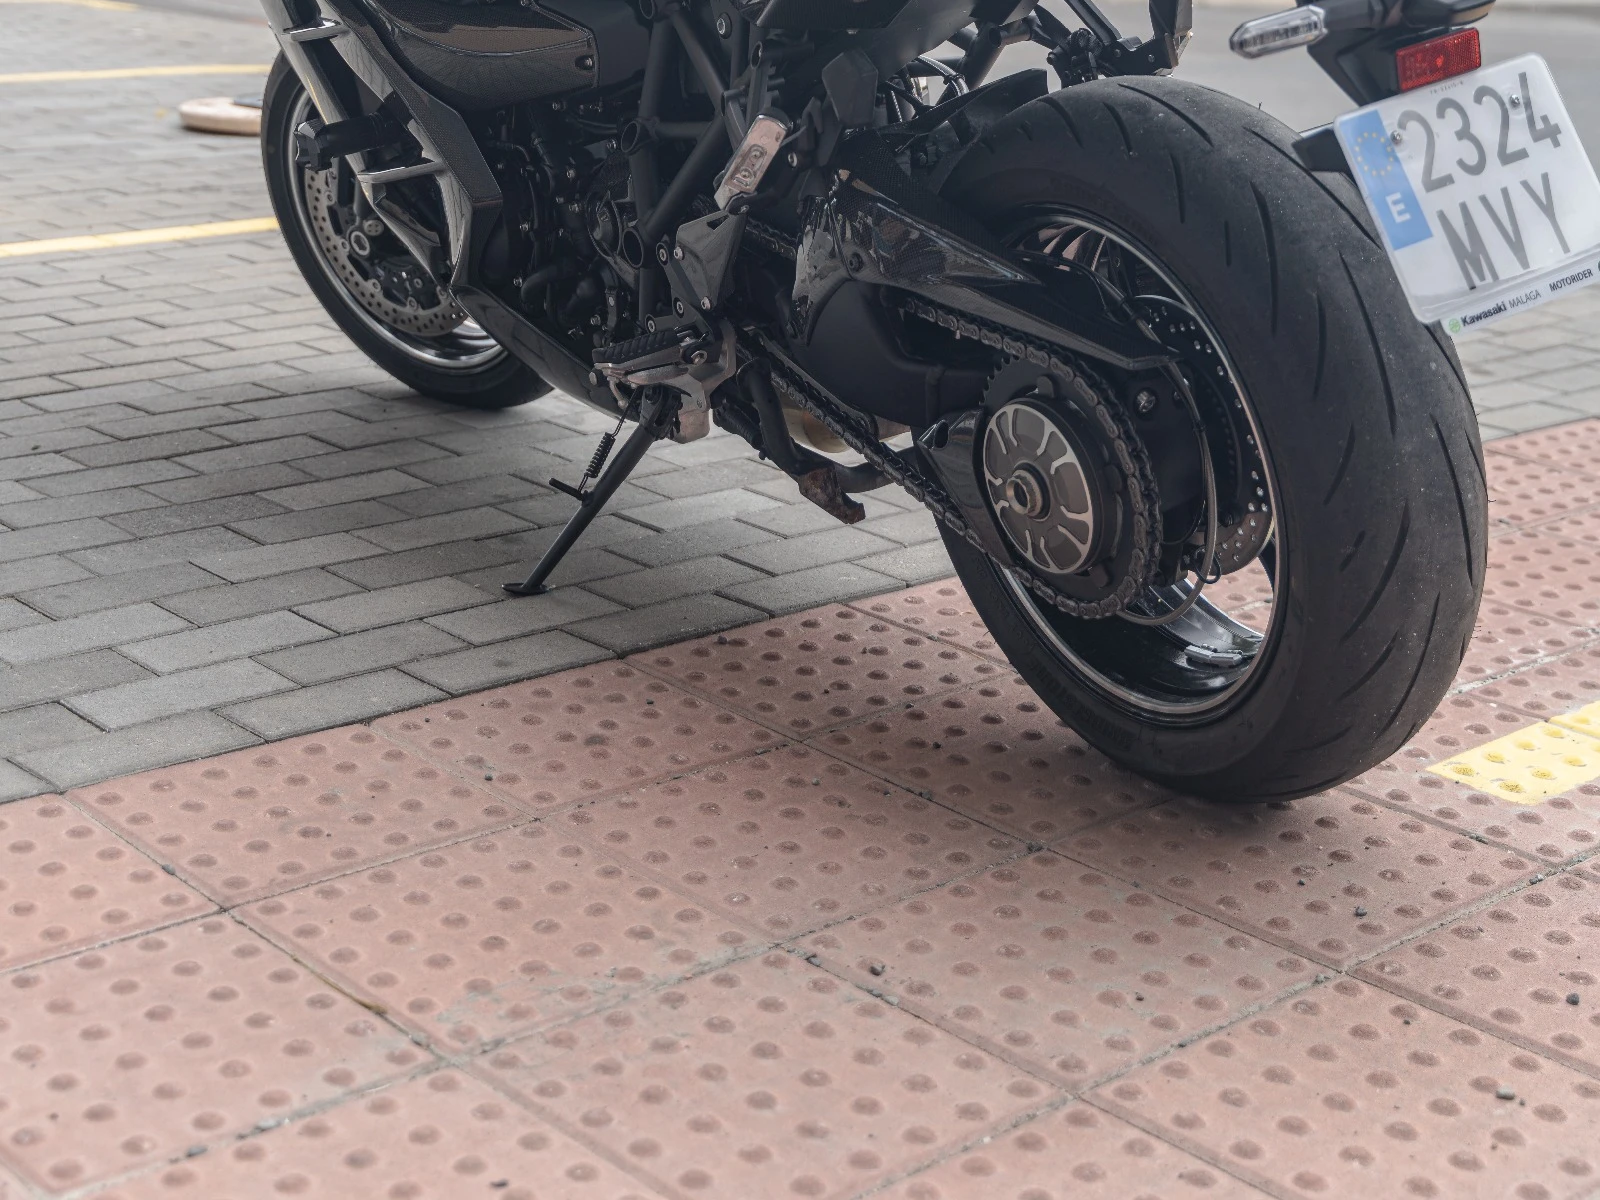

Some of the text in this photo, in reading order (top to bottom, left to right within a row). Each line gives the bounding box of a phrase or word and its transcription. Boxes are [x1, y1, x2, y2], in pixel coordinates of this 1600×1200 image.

[1398, 72, 1562, 193] 2324
[1385, 192, 1411, 223] E
[1437, 172, 1570, 290] MVY
[1460, 268, 1593, 326] Kawasaki MALAGA MOTORIDER
